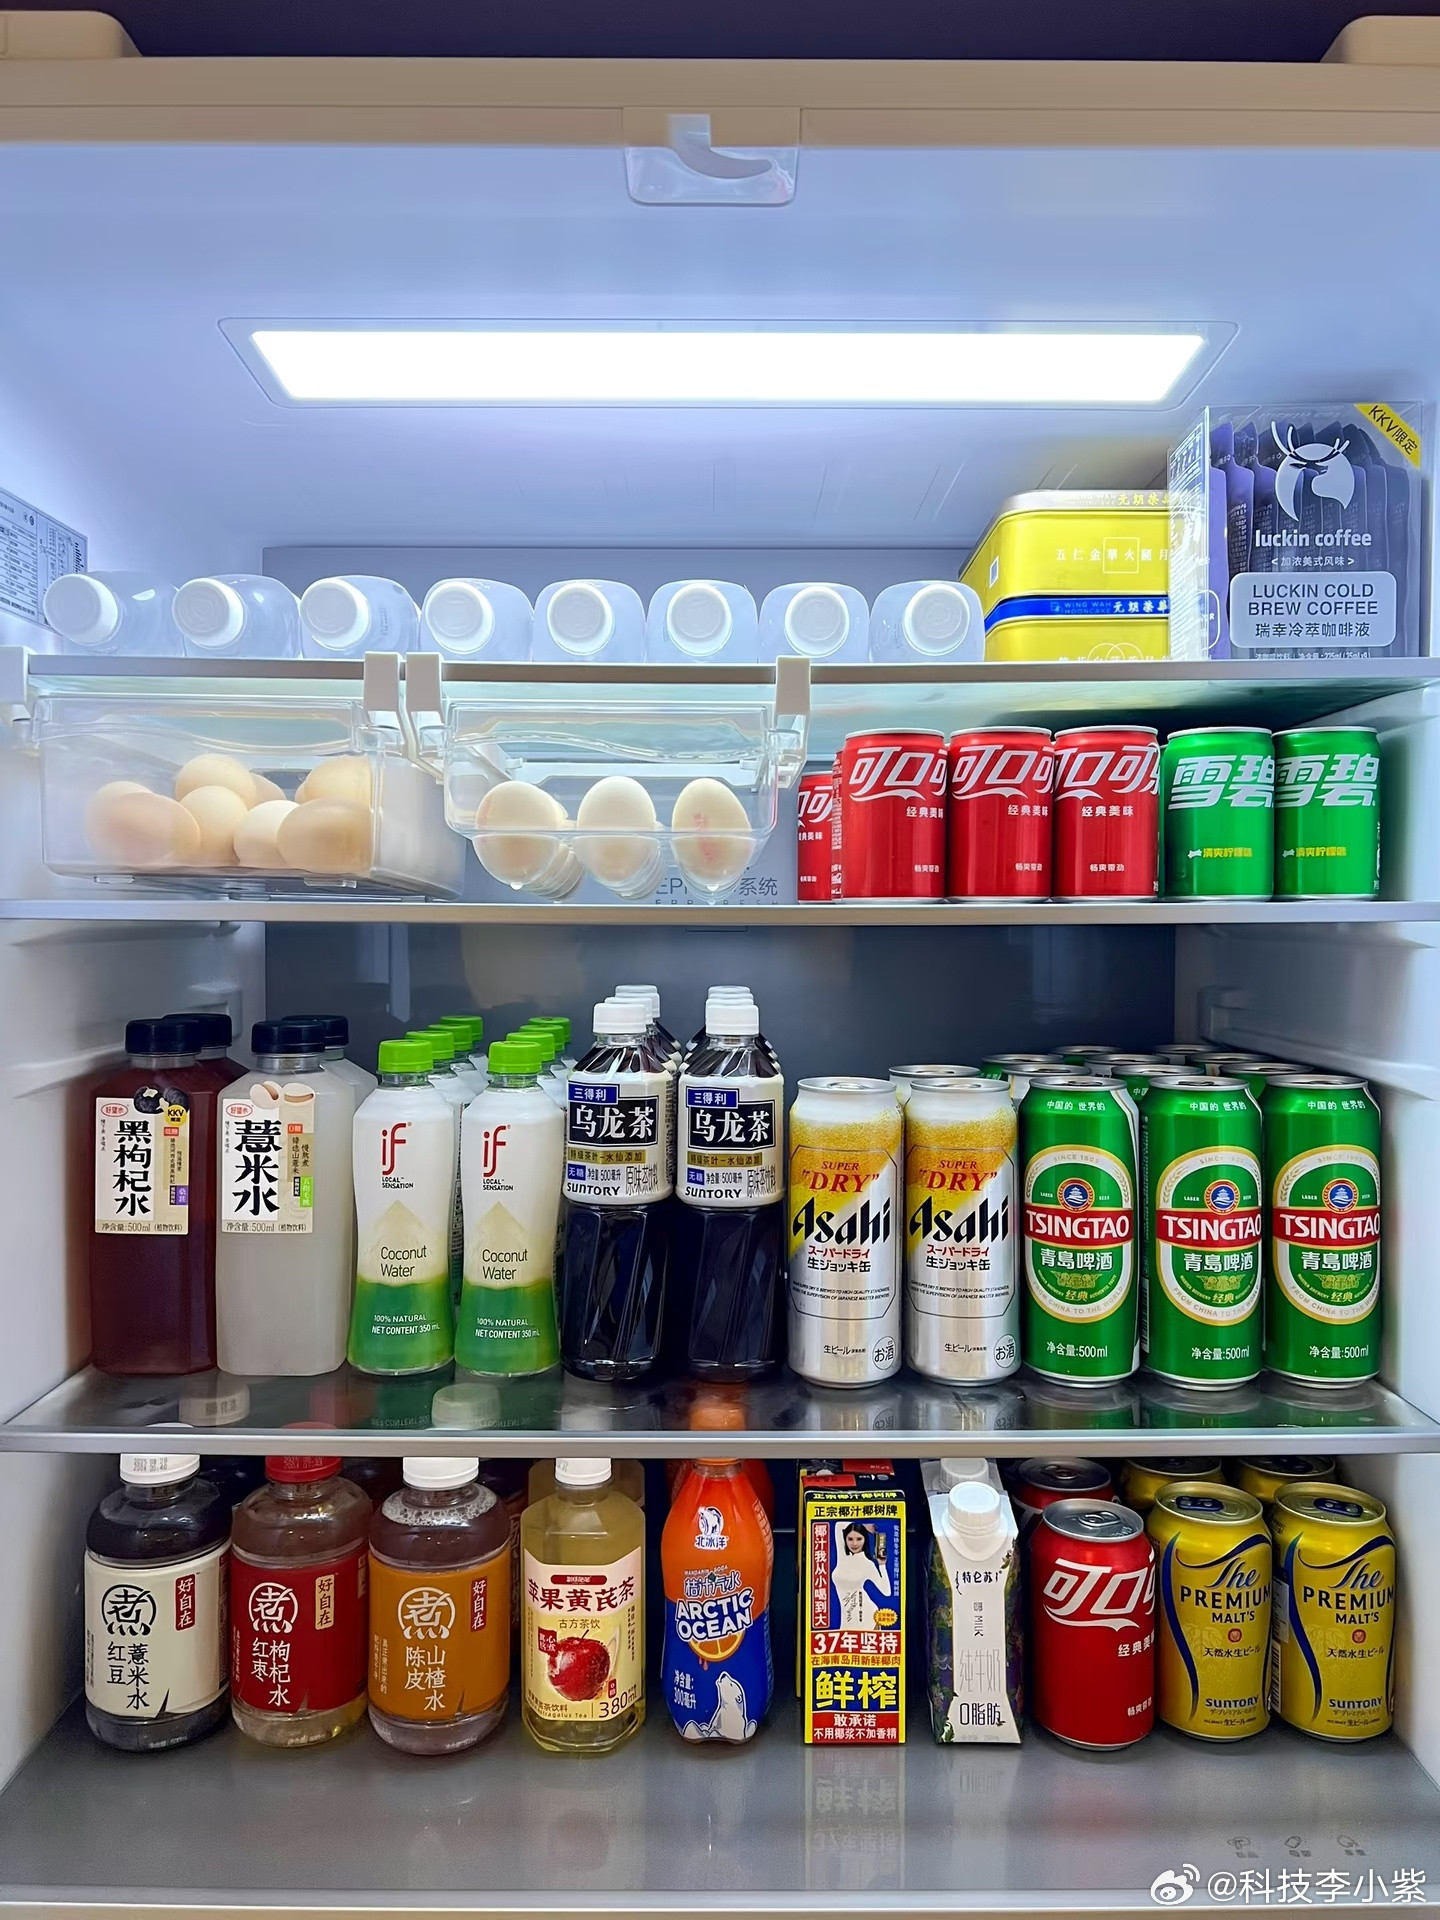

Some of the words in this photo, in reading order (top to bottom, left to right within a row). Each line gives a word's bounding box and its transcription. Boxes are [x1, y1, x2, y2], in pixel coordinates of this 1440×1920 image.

[1367, 404, 1418, 456] KKV限定
[1255, 529, 1310, 547] luckin
[1315, 529, 1372, 547] coffee
[1253, 583, 1319, 598] LUCKIN
[1324, 583, 1374, 598] COLD
[1248, 601, 1302, 616] BREW
[1307, 601, 1378, 615] COFFEE
[1255, 622, 1370, 637] 瑞幸冷萃咖啡液
[1168, 754, 1275, 810] 雪碧
[1275, 753, 1380, 808] 雪碧
[906, 806, 944, 819] 经典美味
[1007, 804, 1049, 817] 经典美味
[1081, 805, 1134, 817] 经典美味
[574, 1087, 607, 1101] 三得利
[694, 1092, 727, 1105] 三得利
[1047, 1100, 1074, 1111] 中国的
[1078, 1101, 1106, 1111] 世界的
[1189, 1101, 1219, 1112] 中国的
[1223, 1101, 1247, 1112] 世界的
[1307, 1100, 1337, 1110] 中国的
[1341, 1100, 1366, 1110] 世界的
[572, 1104, 655, 1139] 乌龙茶
[692, 1109, 771, 1143] 乌龙茶
[381, 1122, 407, 1176] if
[482, 1125, 506, 1177] if
[113, 1120, 152, 1216] 黑枸杞水
[232, 1120, 283, 1216] 薏米水
[568, 1166, 585, 1178] 无糖
[821, 1160, 860, 1171] SUPER
[938, 1159, 977, 1170] SUPER
[688, 1170, 704, 1182] 无糖
[567, 1182, 621, 1196] SUNTORY
[685, 1186, 742, 1199] SUNTORY
[792, 1196, 891, 1245] Asahi
[909, 1195, 1009, 1244] Asahi
[1025, 1210, 1129, 1239] TSINGTAO
[380, 1245, 427, 1261] Coconut
[482, 1249, 528, 1263] Coconut
[808, 1245, 871, 1259] スーパードライ
[926, 1244, 990, 1257] スーパードライ
[380, 1264, 415, 1278] Water
[807, 1258, 872, 1273] 生ジョッキ缶
[926, 1256, 991, 1271] 生ジョッキ缶
[482, 1266, 516, 1280] Water
[1065, 1290, 1088, 1302] 经典
[1212, 1292, 1235, 1304] 经典
[1330, 1291, 1354, 1303] 经典
[1048, 1299, 1071, 1314] CHINA
[1074, 1307, 1085, 1315] TO
[1087, 1305, 1102, 1314] THE
[373, 1315, 391, 1323] 100%
[393, 1314, 427, 1322] NATURAL
[477, 1317, 494, 1326] 100%
[496, 1318, 528, 1326] NATURAL
[372, 1325, 386, 1334] NET
[386, 1325, 418, 1335] CONTENT
[419, 1324, 431, 1333] 350
[475, 1328, 489, 1338] NET
[489, 1329, 521, 1339] CONTENT
[522, 1329, 532, 1338] 350
[823, 1344, 851, 1355] 生ビール
[874, 1344, 895, 1363] お酒
[944, 1342, 972, 1354] 生ビール
[995, 1343, 1015, 1361] お酒
[1046, 1340, 1108, 1358] 净含量:500ml
[1191, 1345, 1250, 1361] 净含量:500ml
[1309, 1344, 1369, 1359] 净含量:500ml
[814, 1505, 898, 1517] 正宗椰汁椰树牌
[695, 1536, 727, 1547] 北冰洋
[814, 1524, 827, 1626] 椰汁我从小喝到大
[961, 1571, 993, 1584] 特仑苏
[1204, 1557, 1260, 1588] The
[1328, 1557, 1384, 1589] The
[528, 1576, 635, 1612] 苹果黄芪茶
[1180, 1585, 1272, 1610] PREMIUM
[1303, 1585, 1394, 1611] PREMIUM
[177, 1577, 195, 1628] 好自在
[317, 1578, 333, 1627] 好自在
[472, 1579, 487, 1630] 好自在
[677, 1588, 753, 1620] ARCTIC
[558, 1619, 601, 1629] 古方茶饮
[677, 1608, 751, 1640] OCEAN
[1211, 1610, 1256, 1624] MALT'S
[1335, 1611, 1380, 1624] MALT'S
[814, 1632, 898, 1654] 37年坚持
[251, 1637, 269, 1682] 红枣
[1203, 1645, 1261, 1659] 天然水生ビール
[1327, 1645, 1384, 1659] 天然水生ビール
[107, 1641, 127, 1685] 红豆
[404, 1646, 426, 1690] 陈皮
[811, 1655, 901, 1666] 在海南岛用新鲜椰肉
[126, 1642, 150, 1710] 薏米水
[268, 1639, 291, 1707] 枸杞水
[424, 1644, 447, 1712] 山楂水
[959, 1648, 1001, 1693] 纯牛奶
[815, 1670, 897, 1710] 鲜榨
[1205, 1695, 1260, 1709] SUNTORY
[1329, 1695, 1383, 1709] SUNTORY
[833, 1713, 877, 1727] 敢承诺
[959, 1703, 1001, 1726] 0脂肪
[813, 1727, 897, 1740] 不用椰浆不加香精
